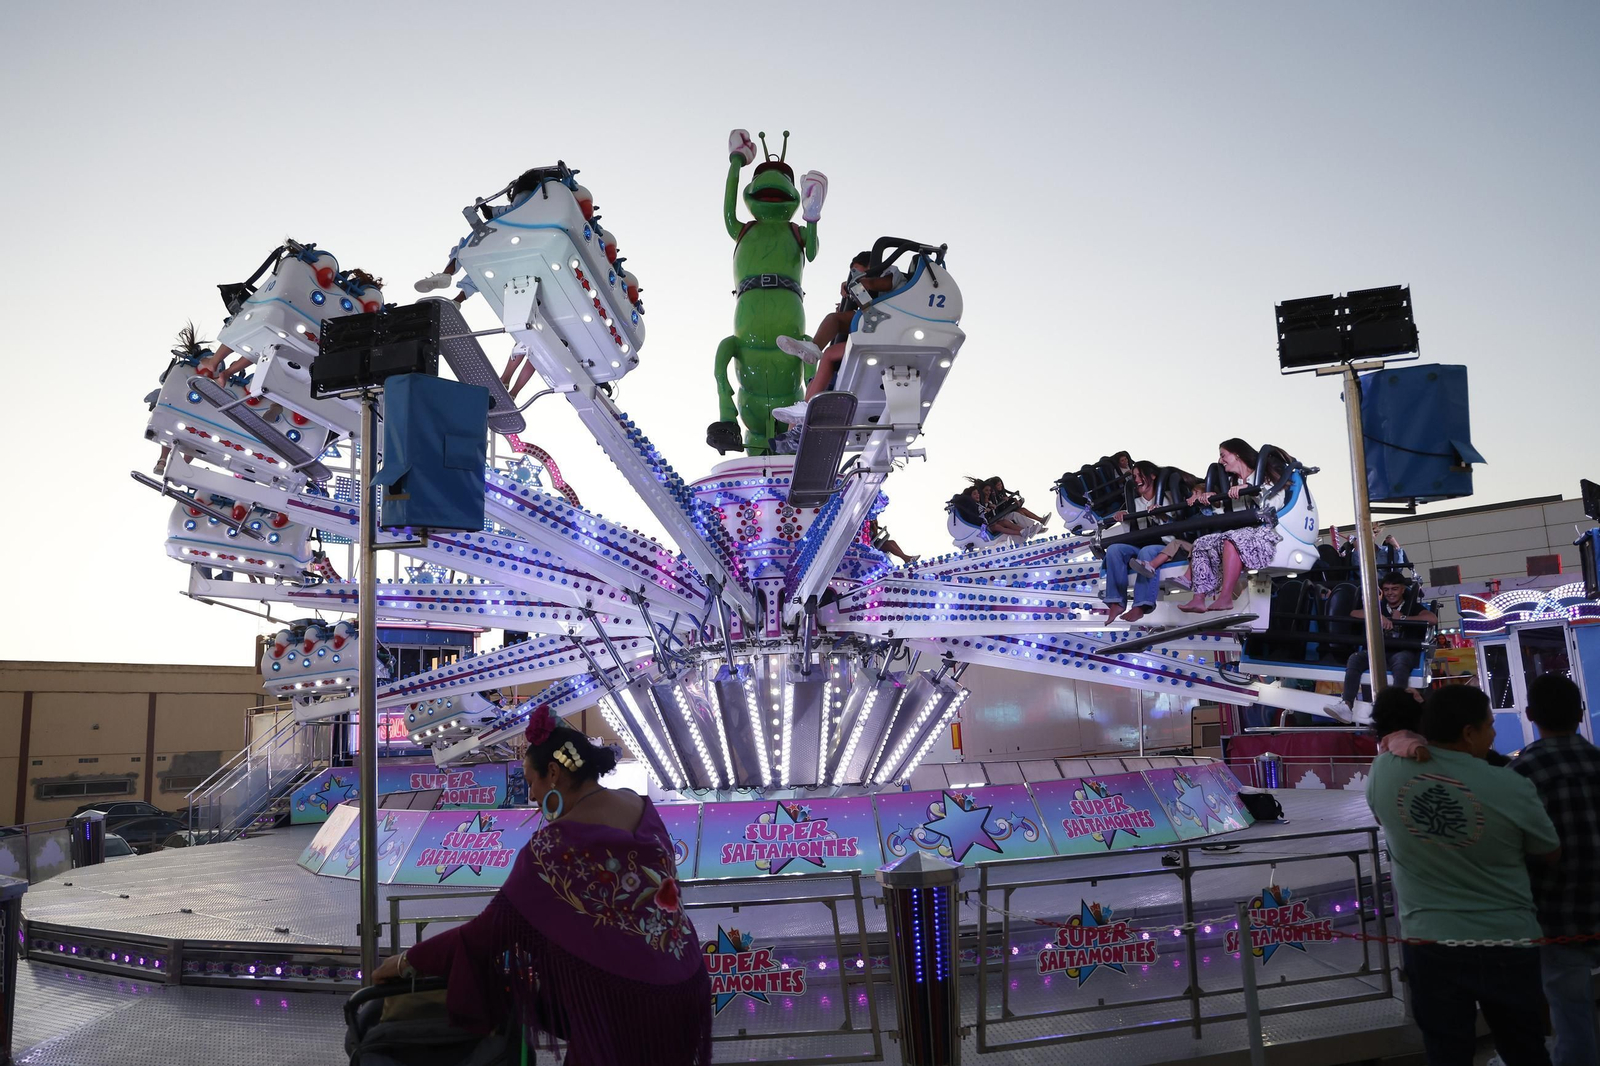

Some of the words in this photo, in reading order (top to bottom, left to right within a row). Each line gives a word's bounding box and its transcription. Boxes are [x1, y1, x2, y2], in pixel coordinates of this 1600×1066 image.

[928, 293, 946, 308] 12
[1304, 516, 1315, 531] 13
[410, 770, 477, 789] SUPER
[436, 786, 497, 804] MONTES
[1069, 795, 1130, 816] SUPER
[746, 820, 830, 841] SUPER
[1062, 809, 1155, 839] SALTAMONTES
[442, 831, 502, 849] SUPER
[720, 836, 858, 864] SALTAMONTES
[416, 848, 515, 868] SALTAMONTES
[1247, 902, 1310, 928] UPER
[1057, 922, 1133, 947] SUPER
[702, 948, 776, 975] UPER
[1039, 940, 1156, 973] SALTAMONTES
[709, 968, 805, 995] AMONTES
